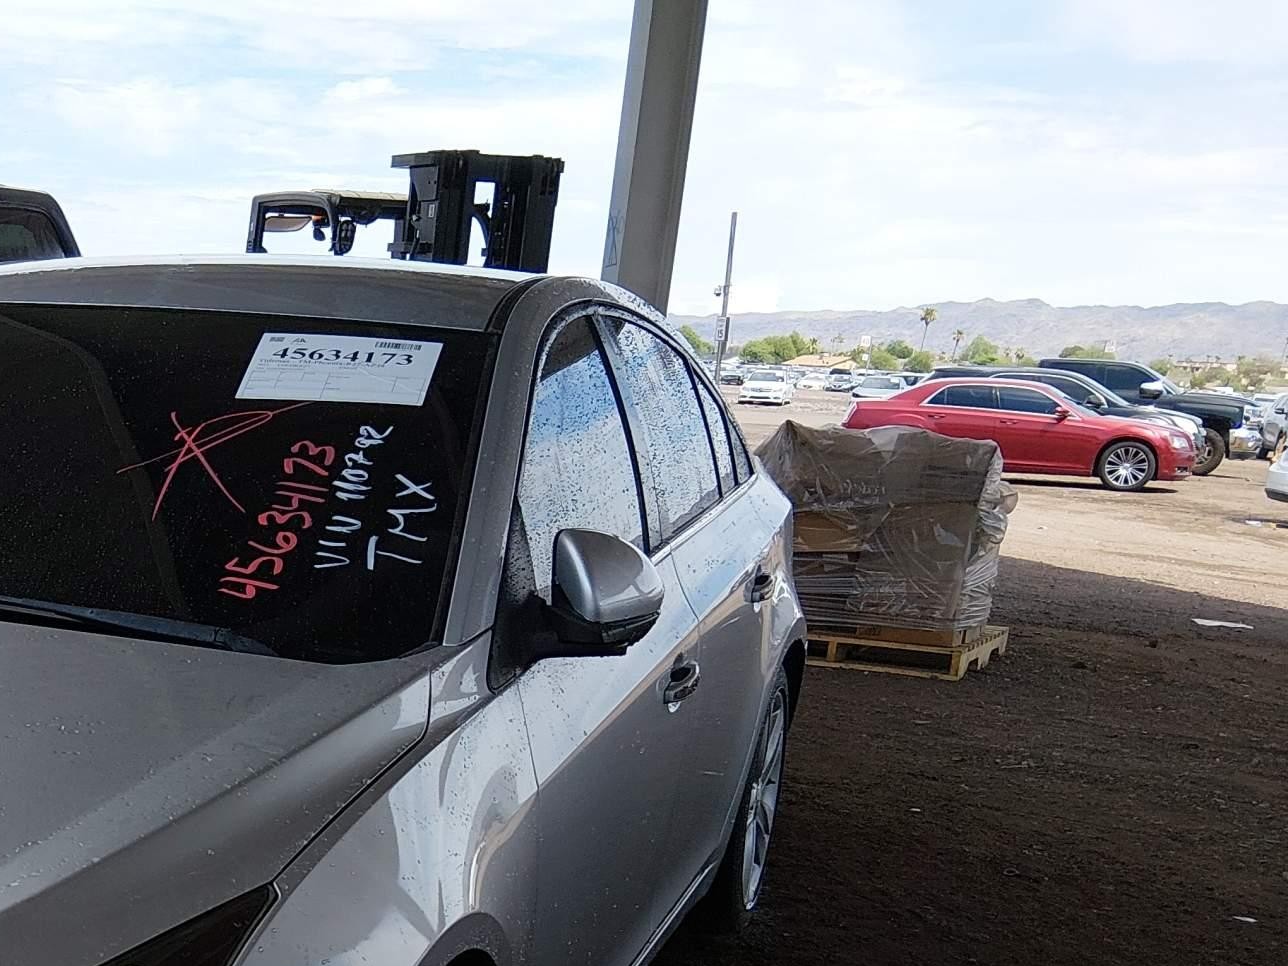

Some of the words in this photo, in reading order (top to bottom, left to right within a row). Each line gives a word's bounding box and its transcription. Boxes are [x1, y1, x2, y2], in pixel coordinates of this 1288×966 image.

[272, 347, 415, 366] 45634173
[717, 329, 724, 339] 15
[218, 441, 336, 600] 45634173
[314, 515, 362, 569] VIN
[367, 473, 437, 571] TMX
